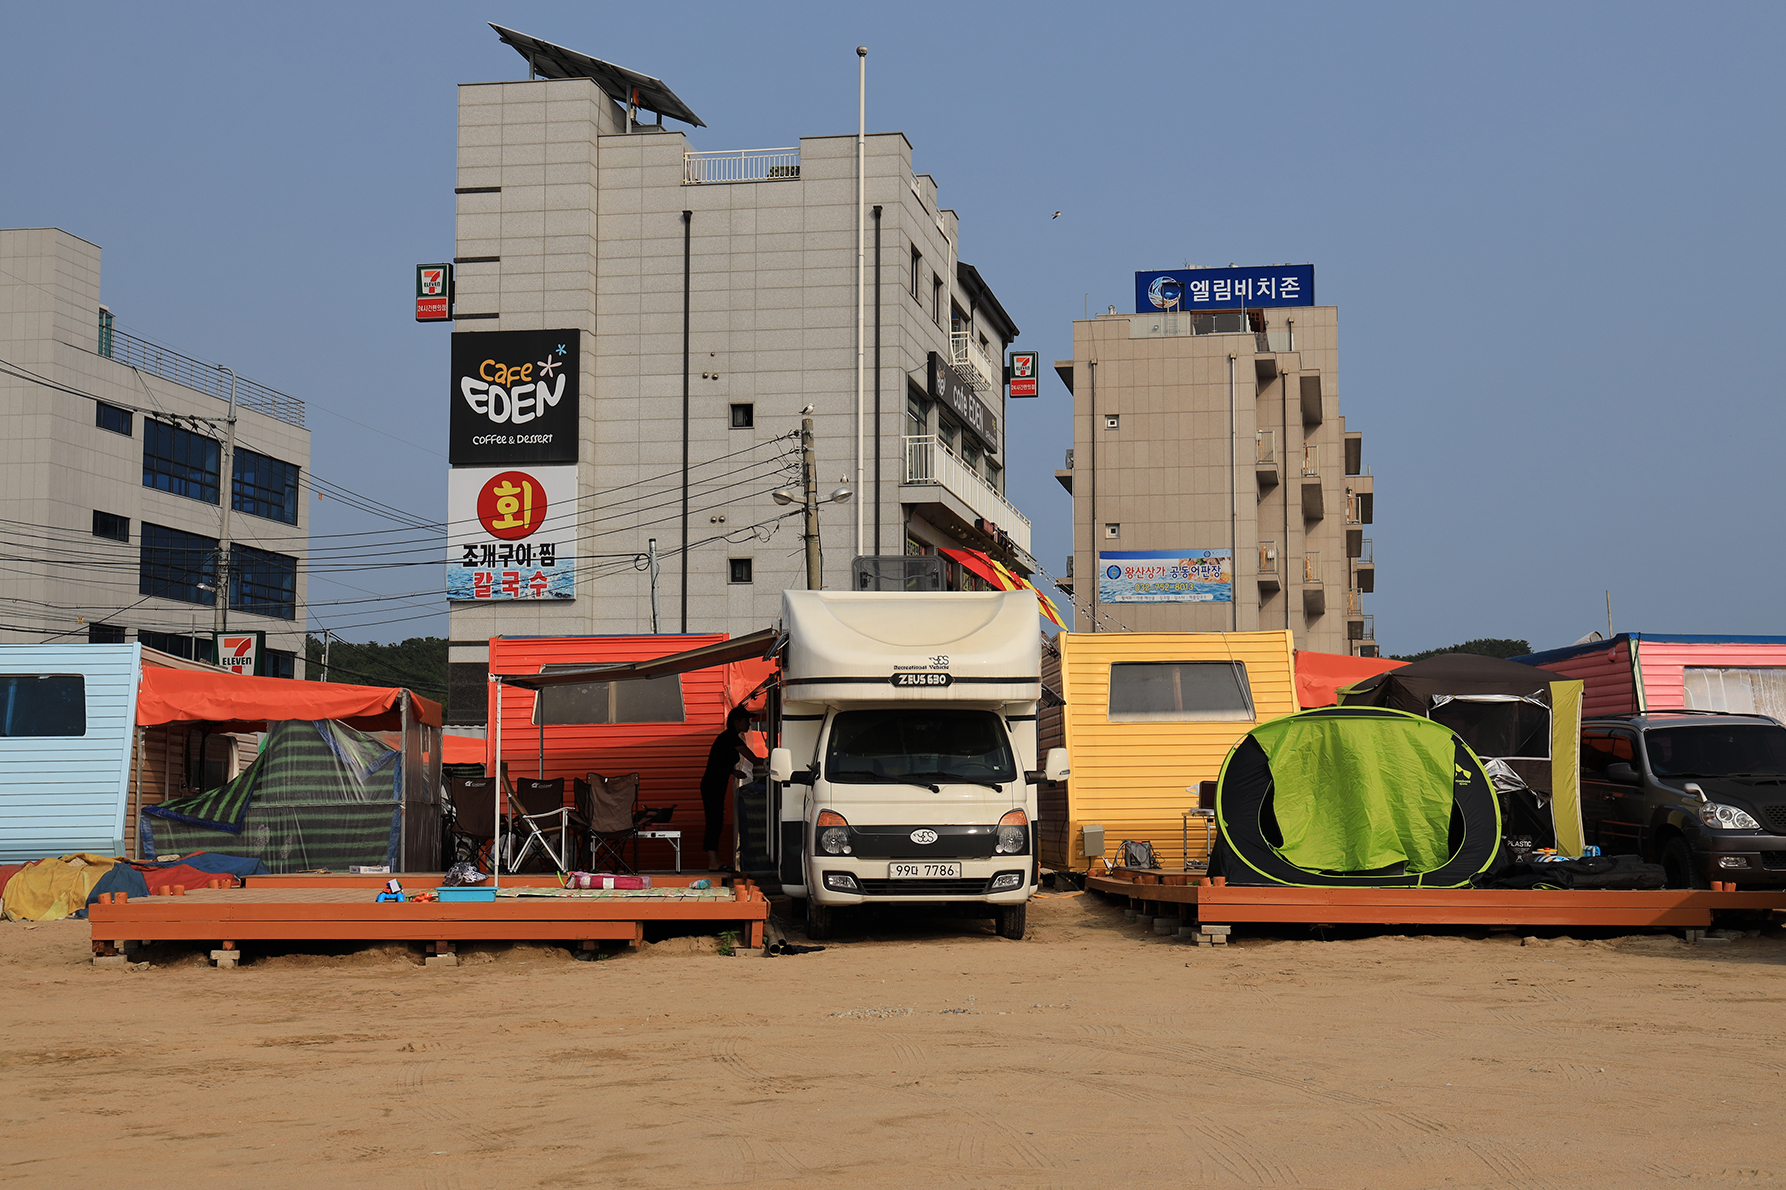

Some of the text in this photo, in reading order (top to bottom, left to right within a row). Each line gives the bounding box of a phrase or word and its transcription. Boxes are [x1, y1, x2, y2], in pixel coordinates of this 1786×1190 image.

[1190, 276, 1300, 302] 엘림비치존
[461, 373, 566, 424] EDEN
[508, 436, 515, 444] &
[492, 480, 532, 529] 회
[1124, 565, 1221, 580] 왕산상가 공동어판장
[1134, 582, 1194, 592] 032-752-8013
[898, 674, 946, 685] ZEUS 630
[896, 865, 955, 876] 99다 7786
